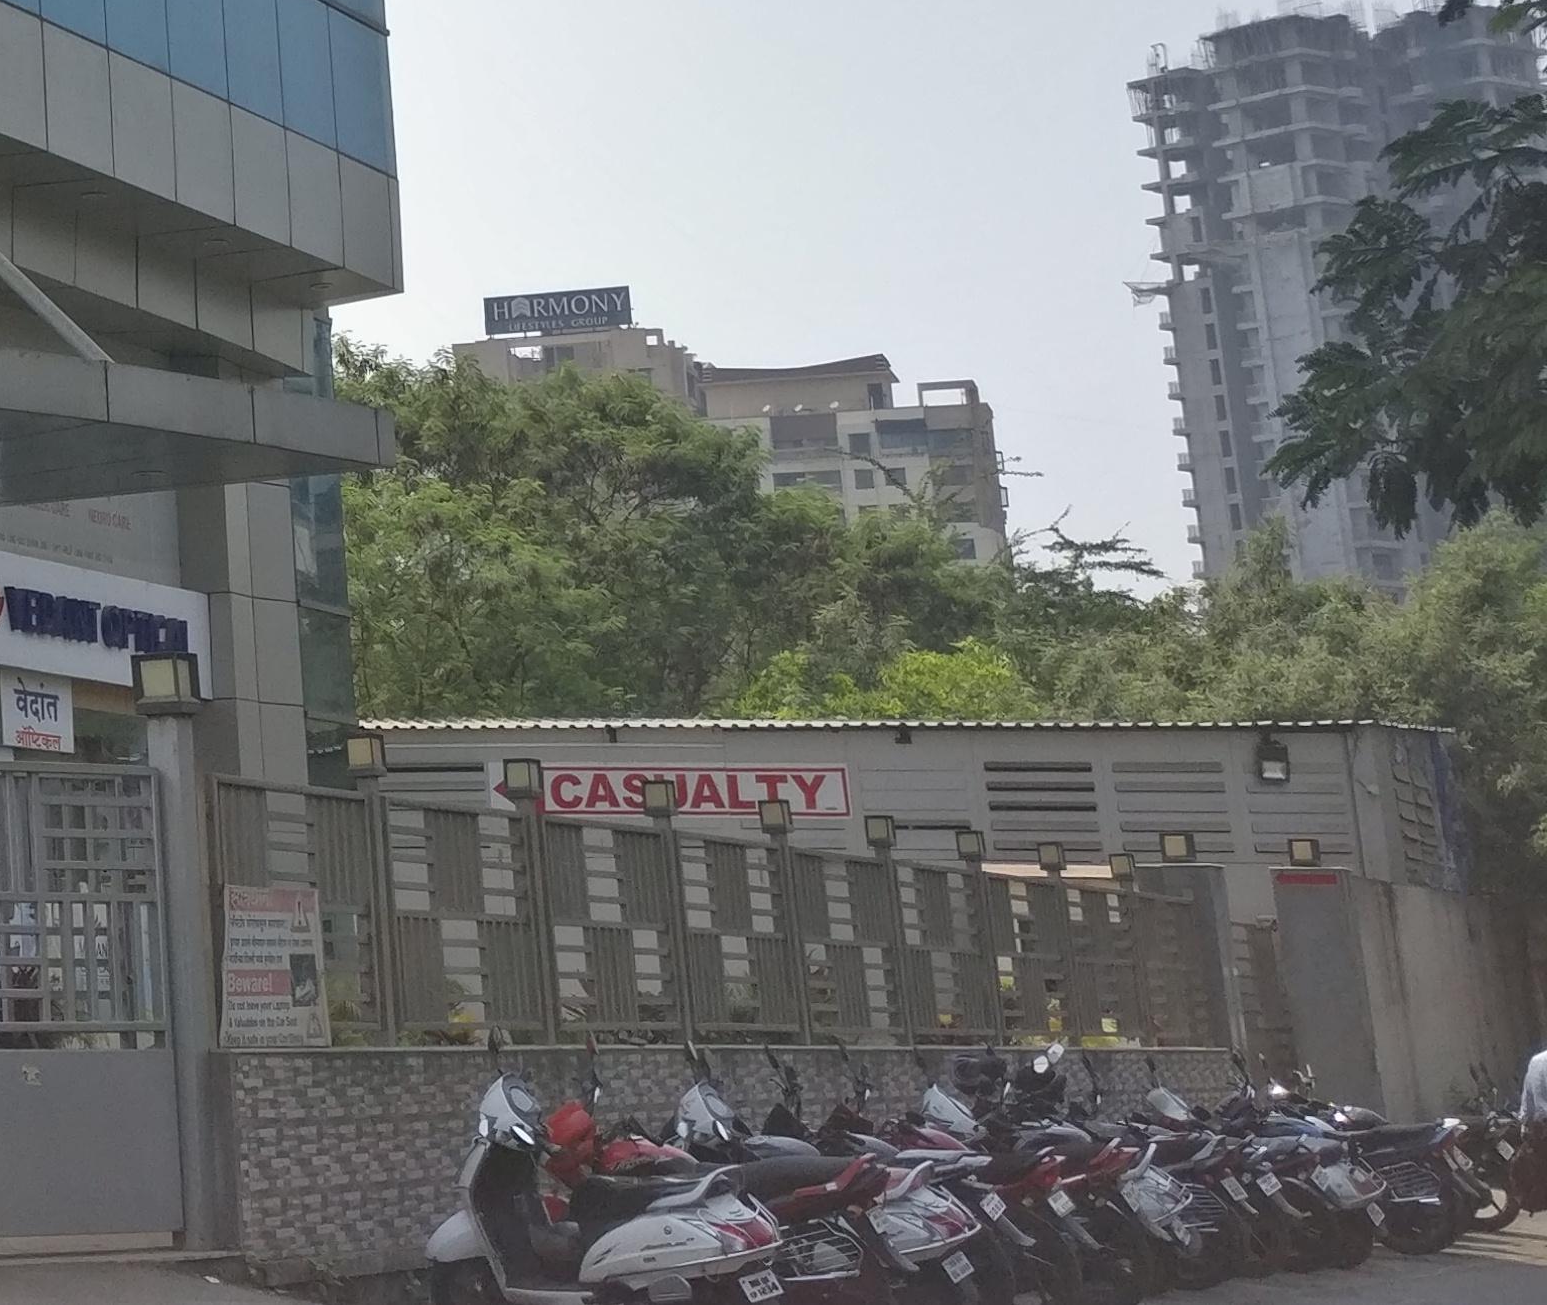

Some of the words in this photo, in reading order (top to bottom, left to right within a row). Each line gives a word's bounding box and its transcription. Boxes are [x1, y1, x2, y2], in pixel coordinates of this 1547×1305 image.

[571, 316, 608, 327] GROUP
[13, 676, 60, 723] वेदांत
[227, 972, 273, 993] Beware!
